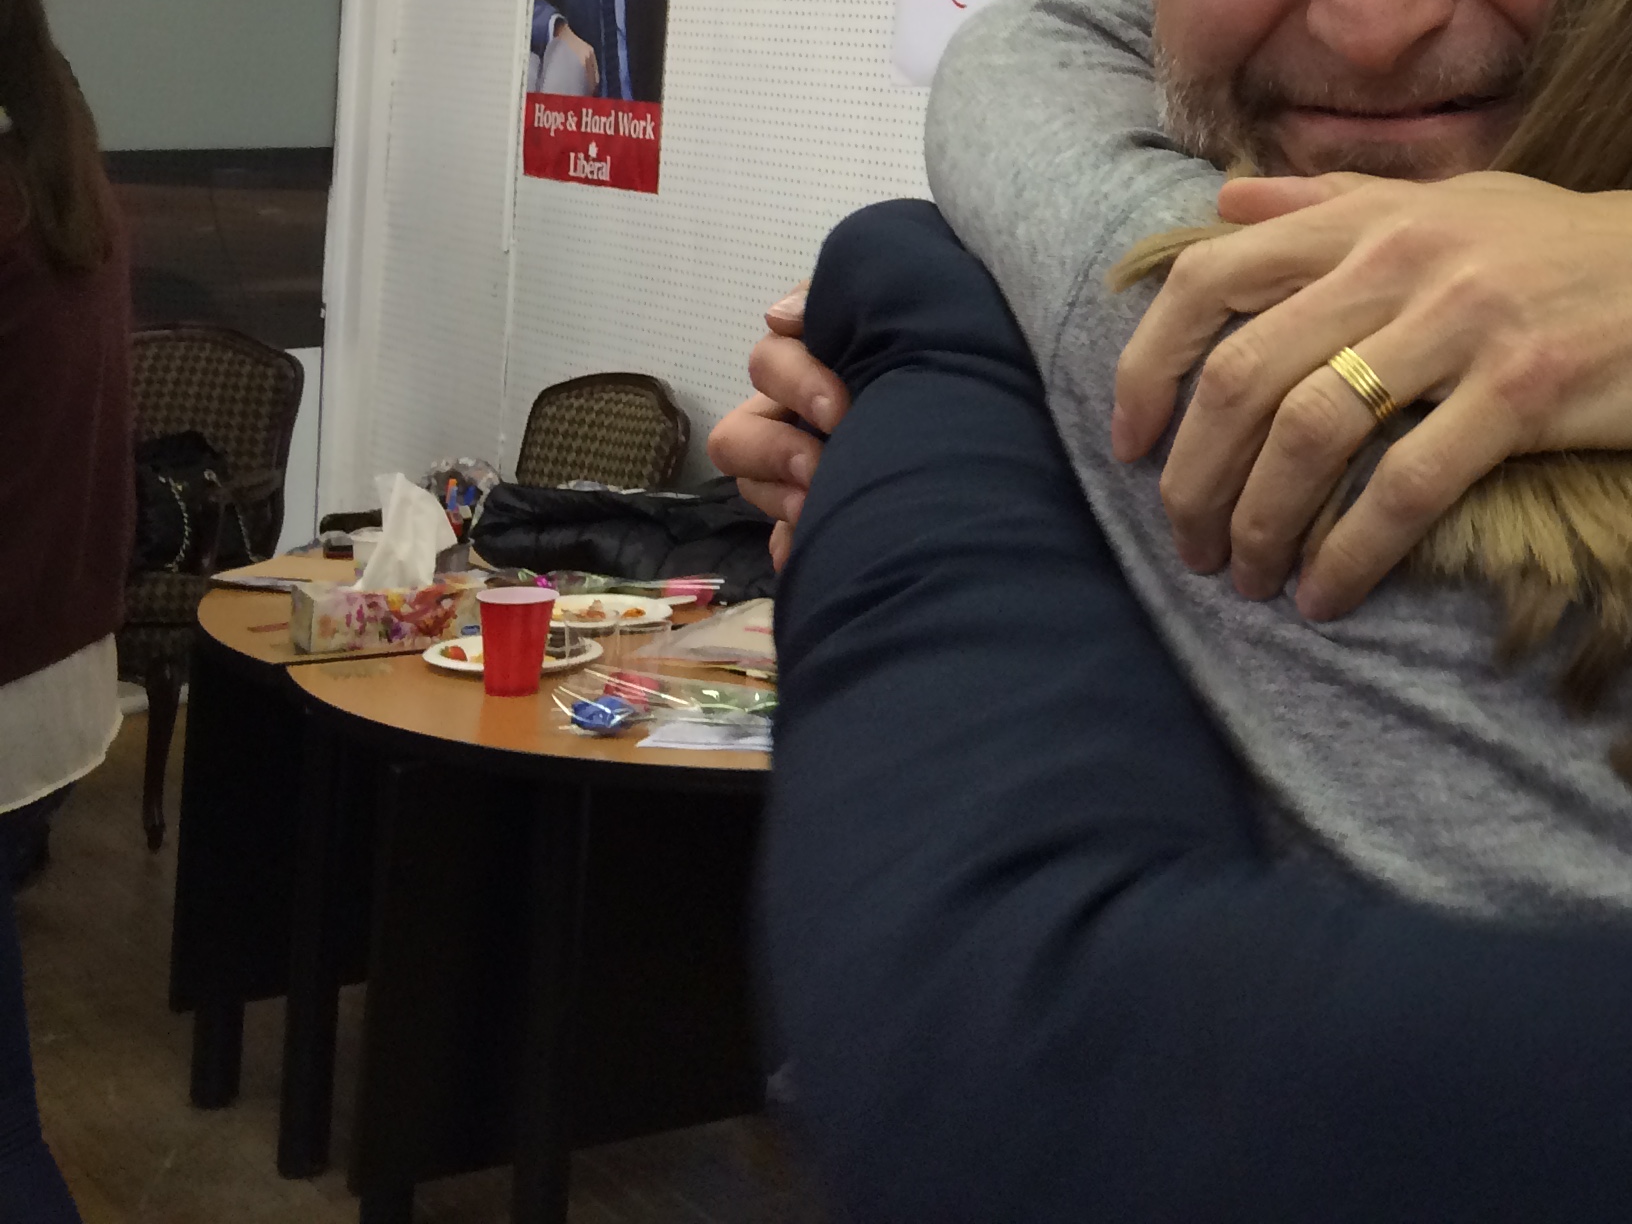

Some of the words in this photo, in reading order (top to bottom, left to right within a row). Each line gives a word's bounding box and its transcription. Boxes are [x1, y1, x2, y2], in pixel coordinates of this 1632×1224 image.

[534, 103, 565, 136] Hope
[566, 111, 578, 131] &
[581, 108, 615, 136] Hard
[618, 112, 655, 140] Work
[568, 152, 611, 181] Liberal
